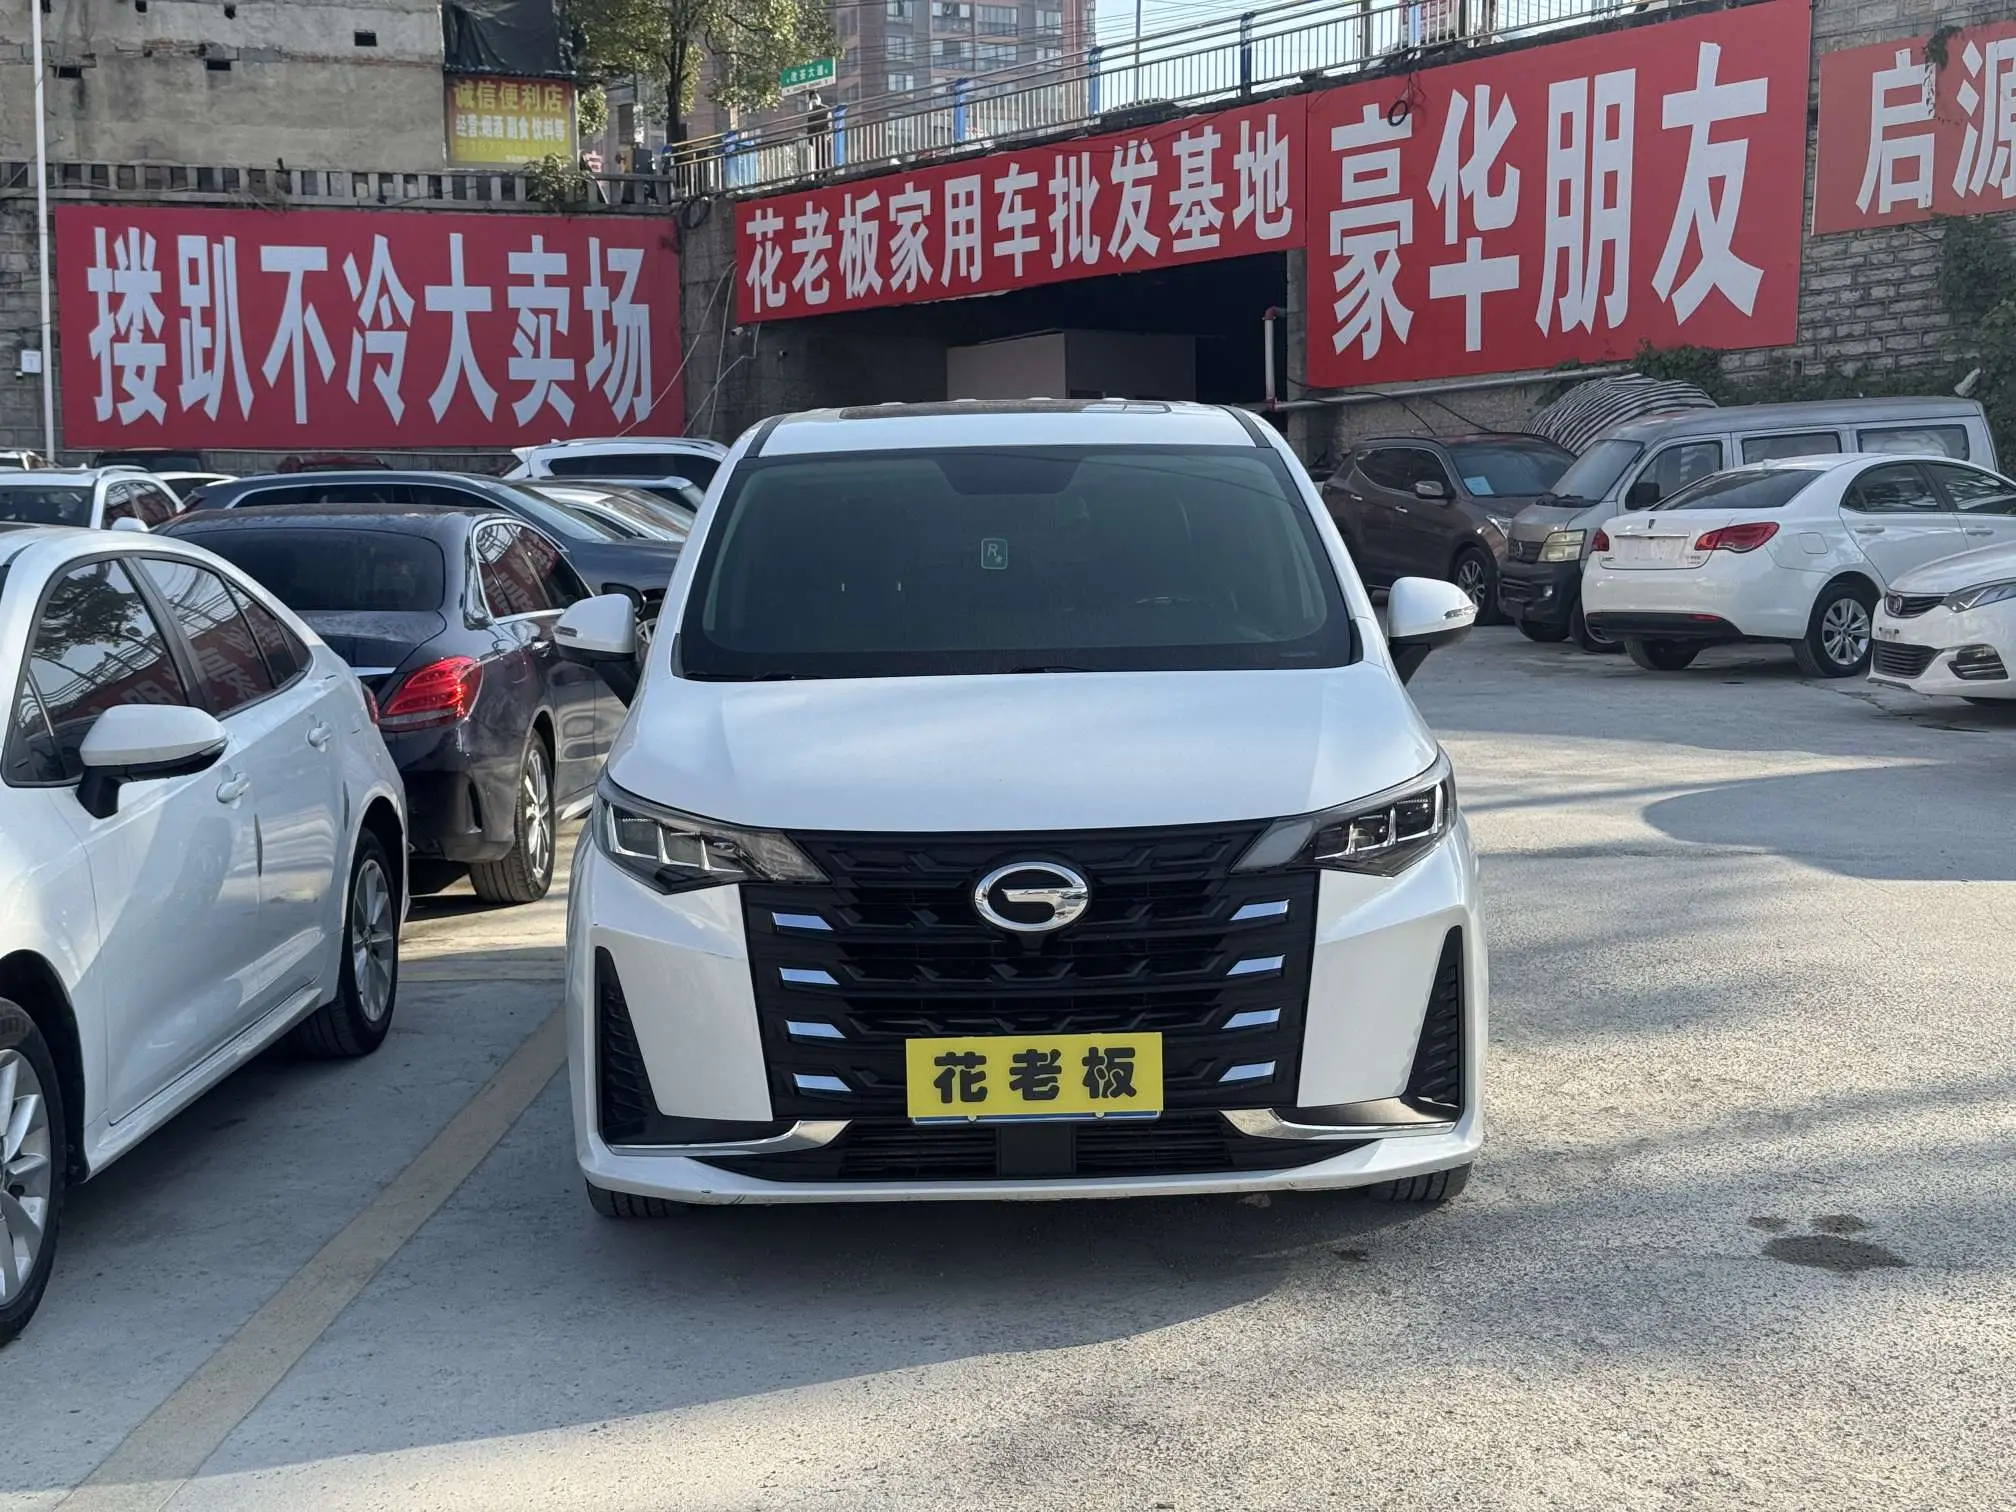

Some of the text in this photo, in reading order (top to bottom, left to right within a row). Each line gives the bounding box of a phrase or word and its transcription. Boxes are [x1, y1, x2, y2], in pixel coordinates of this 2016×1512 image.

[453, 80, 563, 113] 诚信便利店
[1855, 37, 2016, 215] 启源
[745, 113, 1293, 314] 花老板家用车批发基地
[1330, 41, 1769, 361] 豪华朋友
[87, 226, 653, 427] 搂趴不冷大卖场
[933, 1046, 1137, 1104] 花老板
